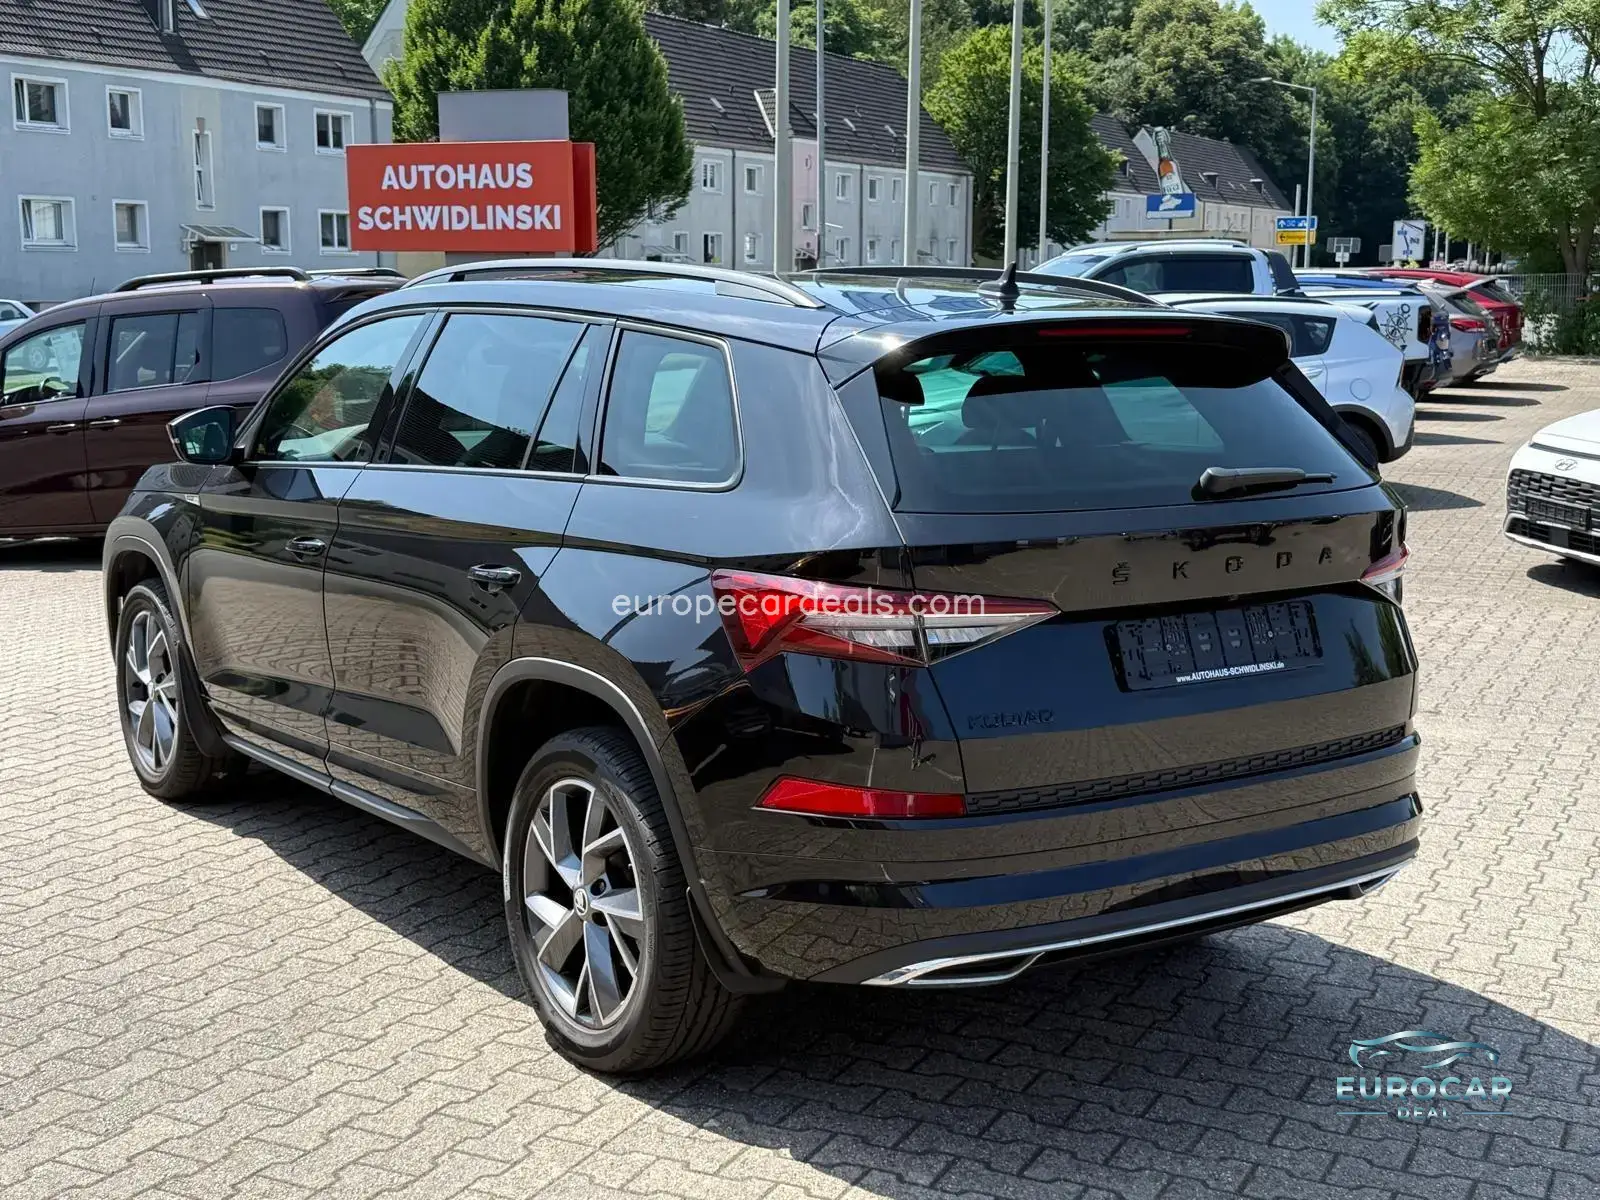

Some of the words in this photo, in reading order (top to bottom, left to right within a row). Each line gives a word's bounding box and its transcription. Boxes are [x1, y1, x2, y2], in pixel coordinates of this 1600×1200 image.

[381, 163, 533, 190] AUTOHAUS
[357, 204, 561, 231] SCHWIDLINSKI
[1176, 661, 1285, 683] www.AUTOHAUS-SCHWIDLINSKI.de
